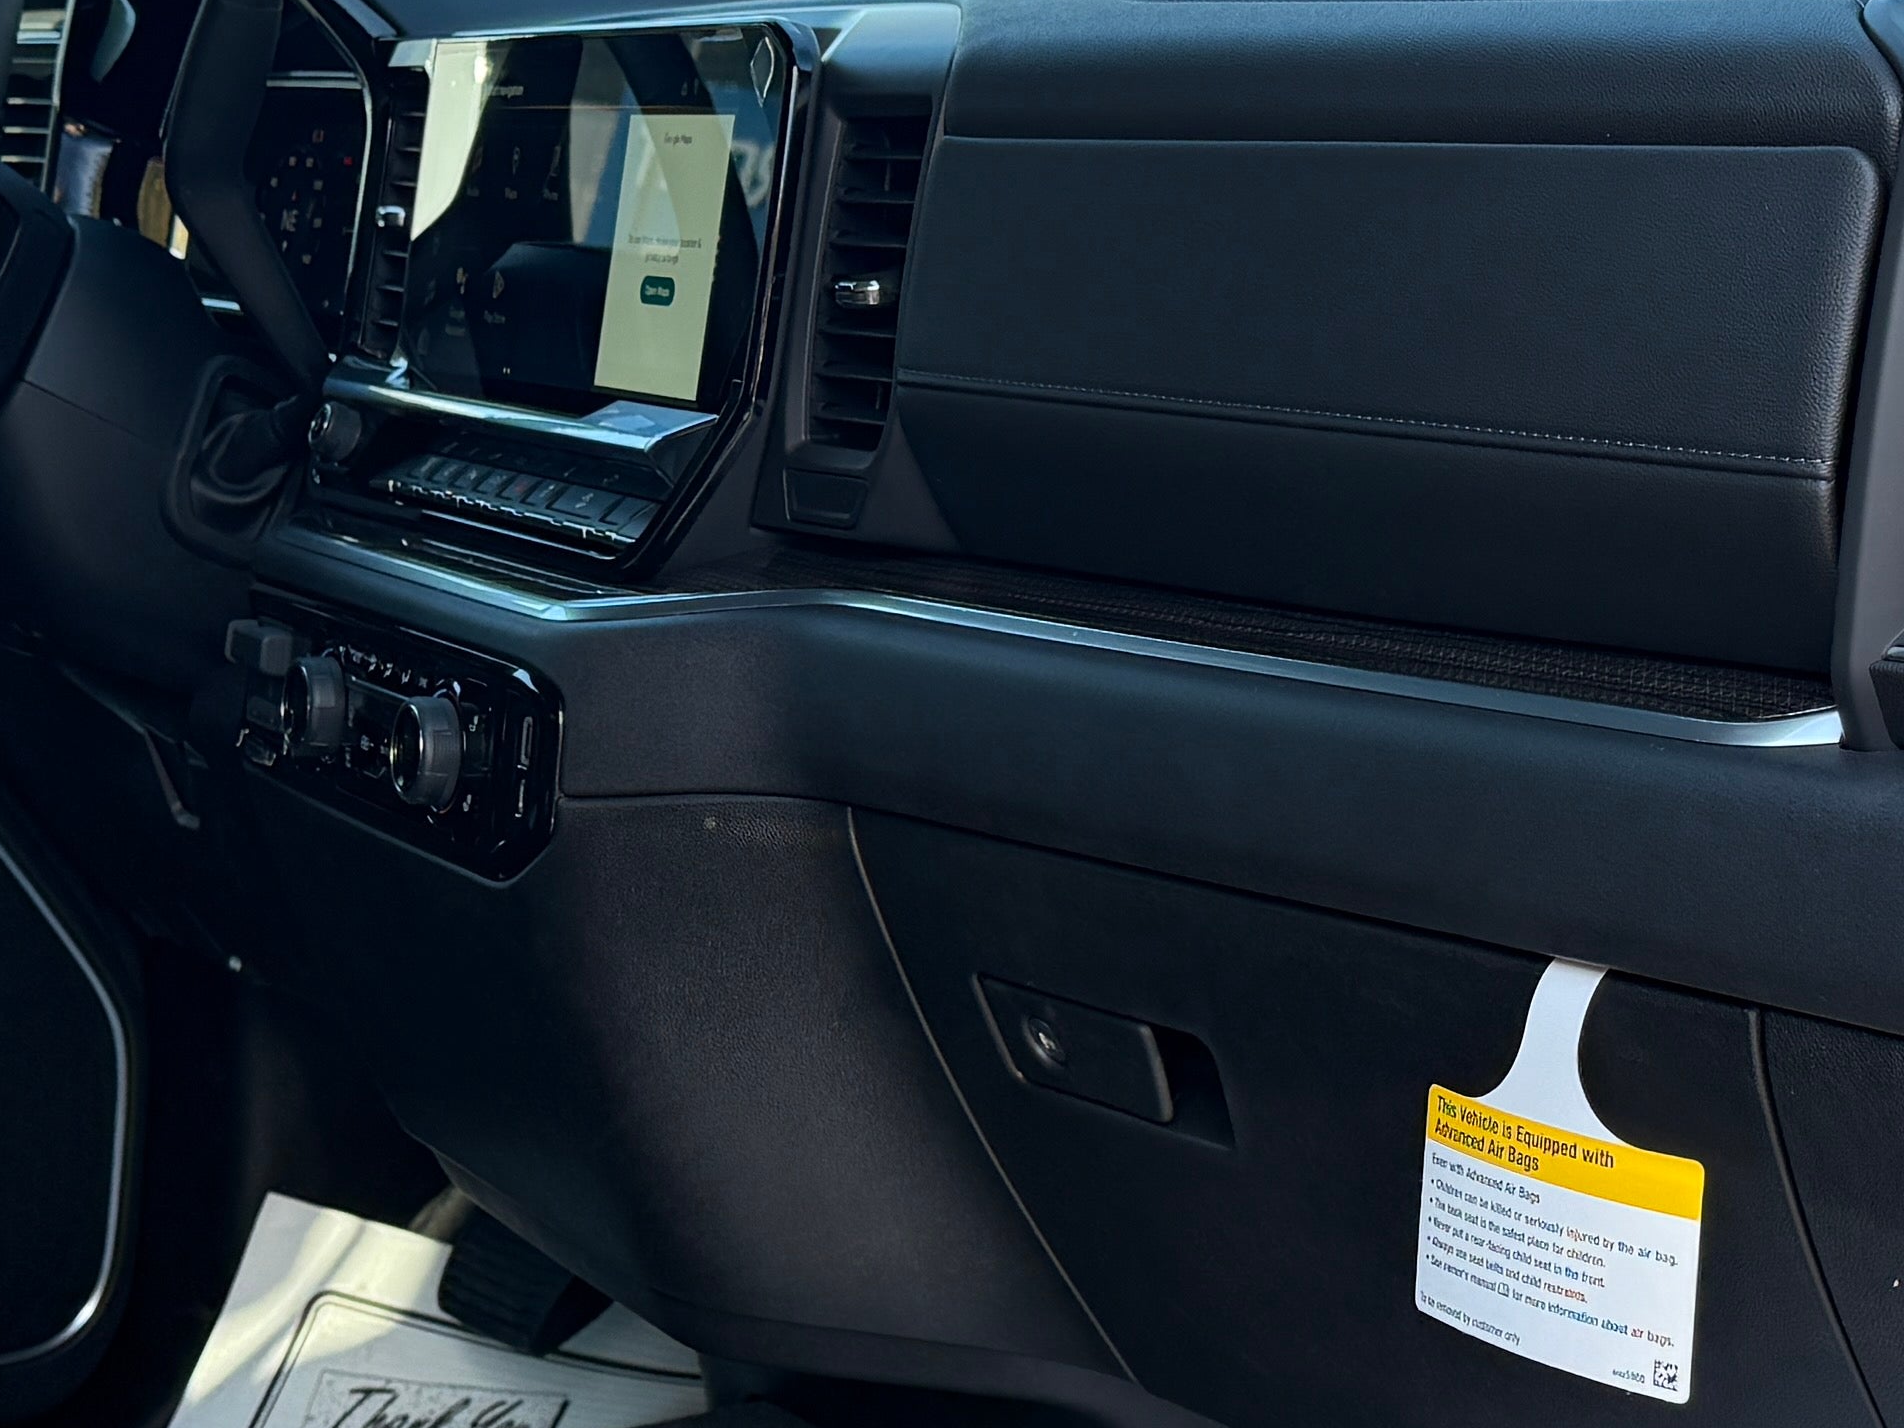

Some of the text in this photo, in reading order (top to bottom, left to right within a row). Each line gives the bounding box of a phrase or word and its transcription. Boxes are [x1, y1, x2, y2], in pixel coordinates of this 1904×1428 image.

[1435, 1118, 1539, 1172] Advanced Air Bags
[1437, 1095, 1614, 1169] This Vehicle is Equipped with
[1450, 1161, 1464, 1176] with
[1466, 1168, 1503, 1191] Advanced
[1505, 1181, 1516, 1197] Air
[1518, 1185, 1540, 1205] Bags
[1464, 1212, 1479, 1226] seat
[1489, 1220, 1500, 1234] the
[1502, 1226, 1526, 1243] safest
[1566, 1249, 1606, 1268] children.
[1465, 1193, 1478, 1205] can
[1491, 1200, 1512, 1220] killed
[1514, 1210, 1523, 1222] or
[1525, 1214, 1564, 1238] seriously
[1566, 1227, 1600, 1246] injured
[1602, 1236, 1615, 1252] by
[1618, 1241, 1634, 1256] the
[1637, 1247, 1651, 1260] air
[1655, 1250, 1679, 1268] bag.
[1512, 1249, 1532, 1265] child
[1565, 1267, 1579, 1281] the
[1521, 1273, 1542, 1290] child
[1548, 1301, 1598, 1327] information
[1600, 1318, 1628, 1336] about
[1630, 1327, 1644, 1339] air
[1647, 1329, 1675, 1348] bags.
